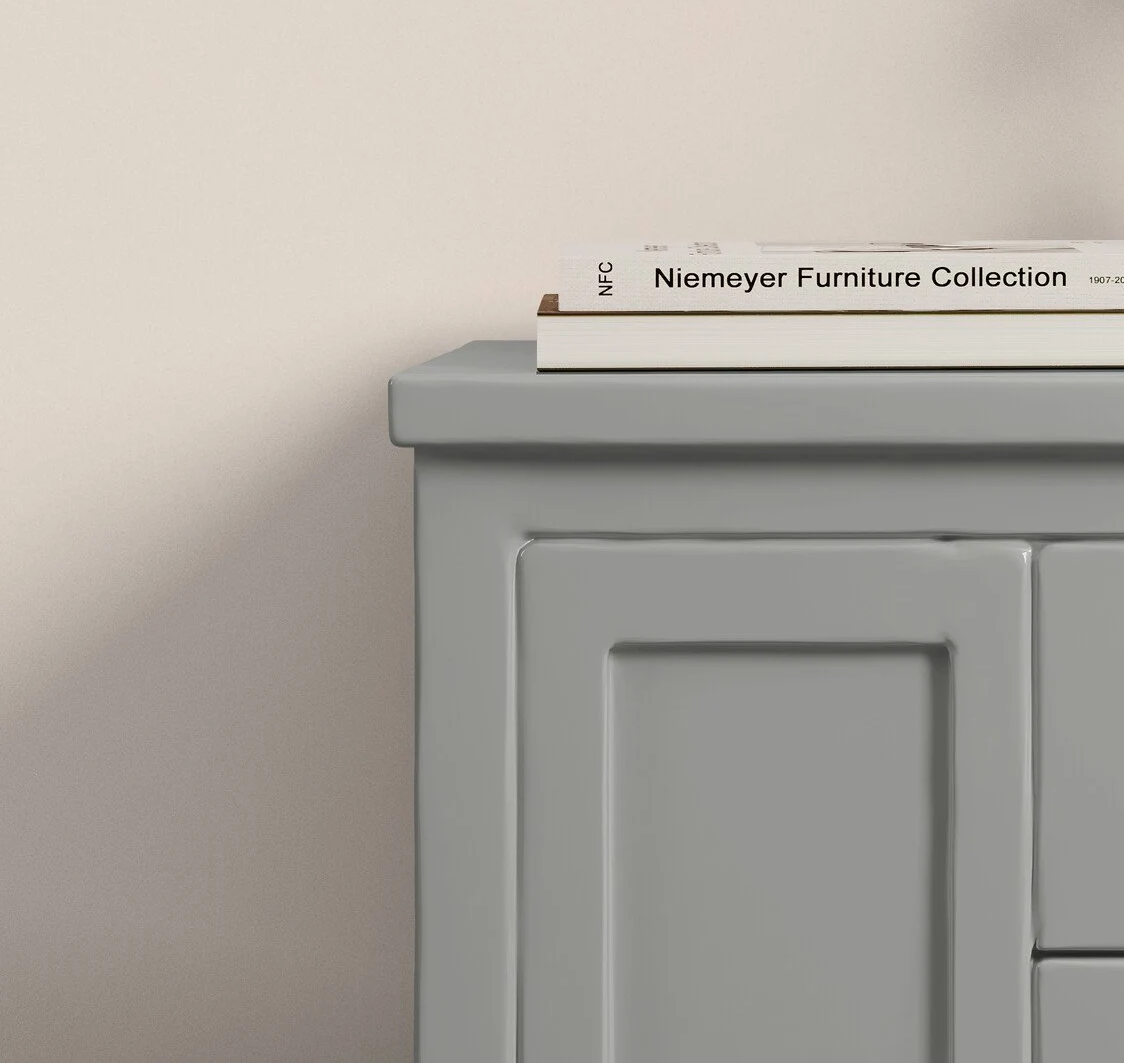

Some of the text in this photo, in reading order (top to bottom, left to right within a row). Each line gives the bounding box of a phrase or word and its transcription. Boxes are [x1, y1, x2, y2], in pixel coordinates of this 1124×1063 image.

[598, 261, 613, 296] NFC
[654, 266, 1067, 293] Niemeyer Furniture Collection
